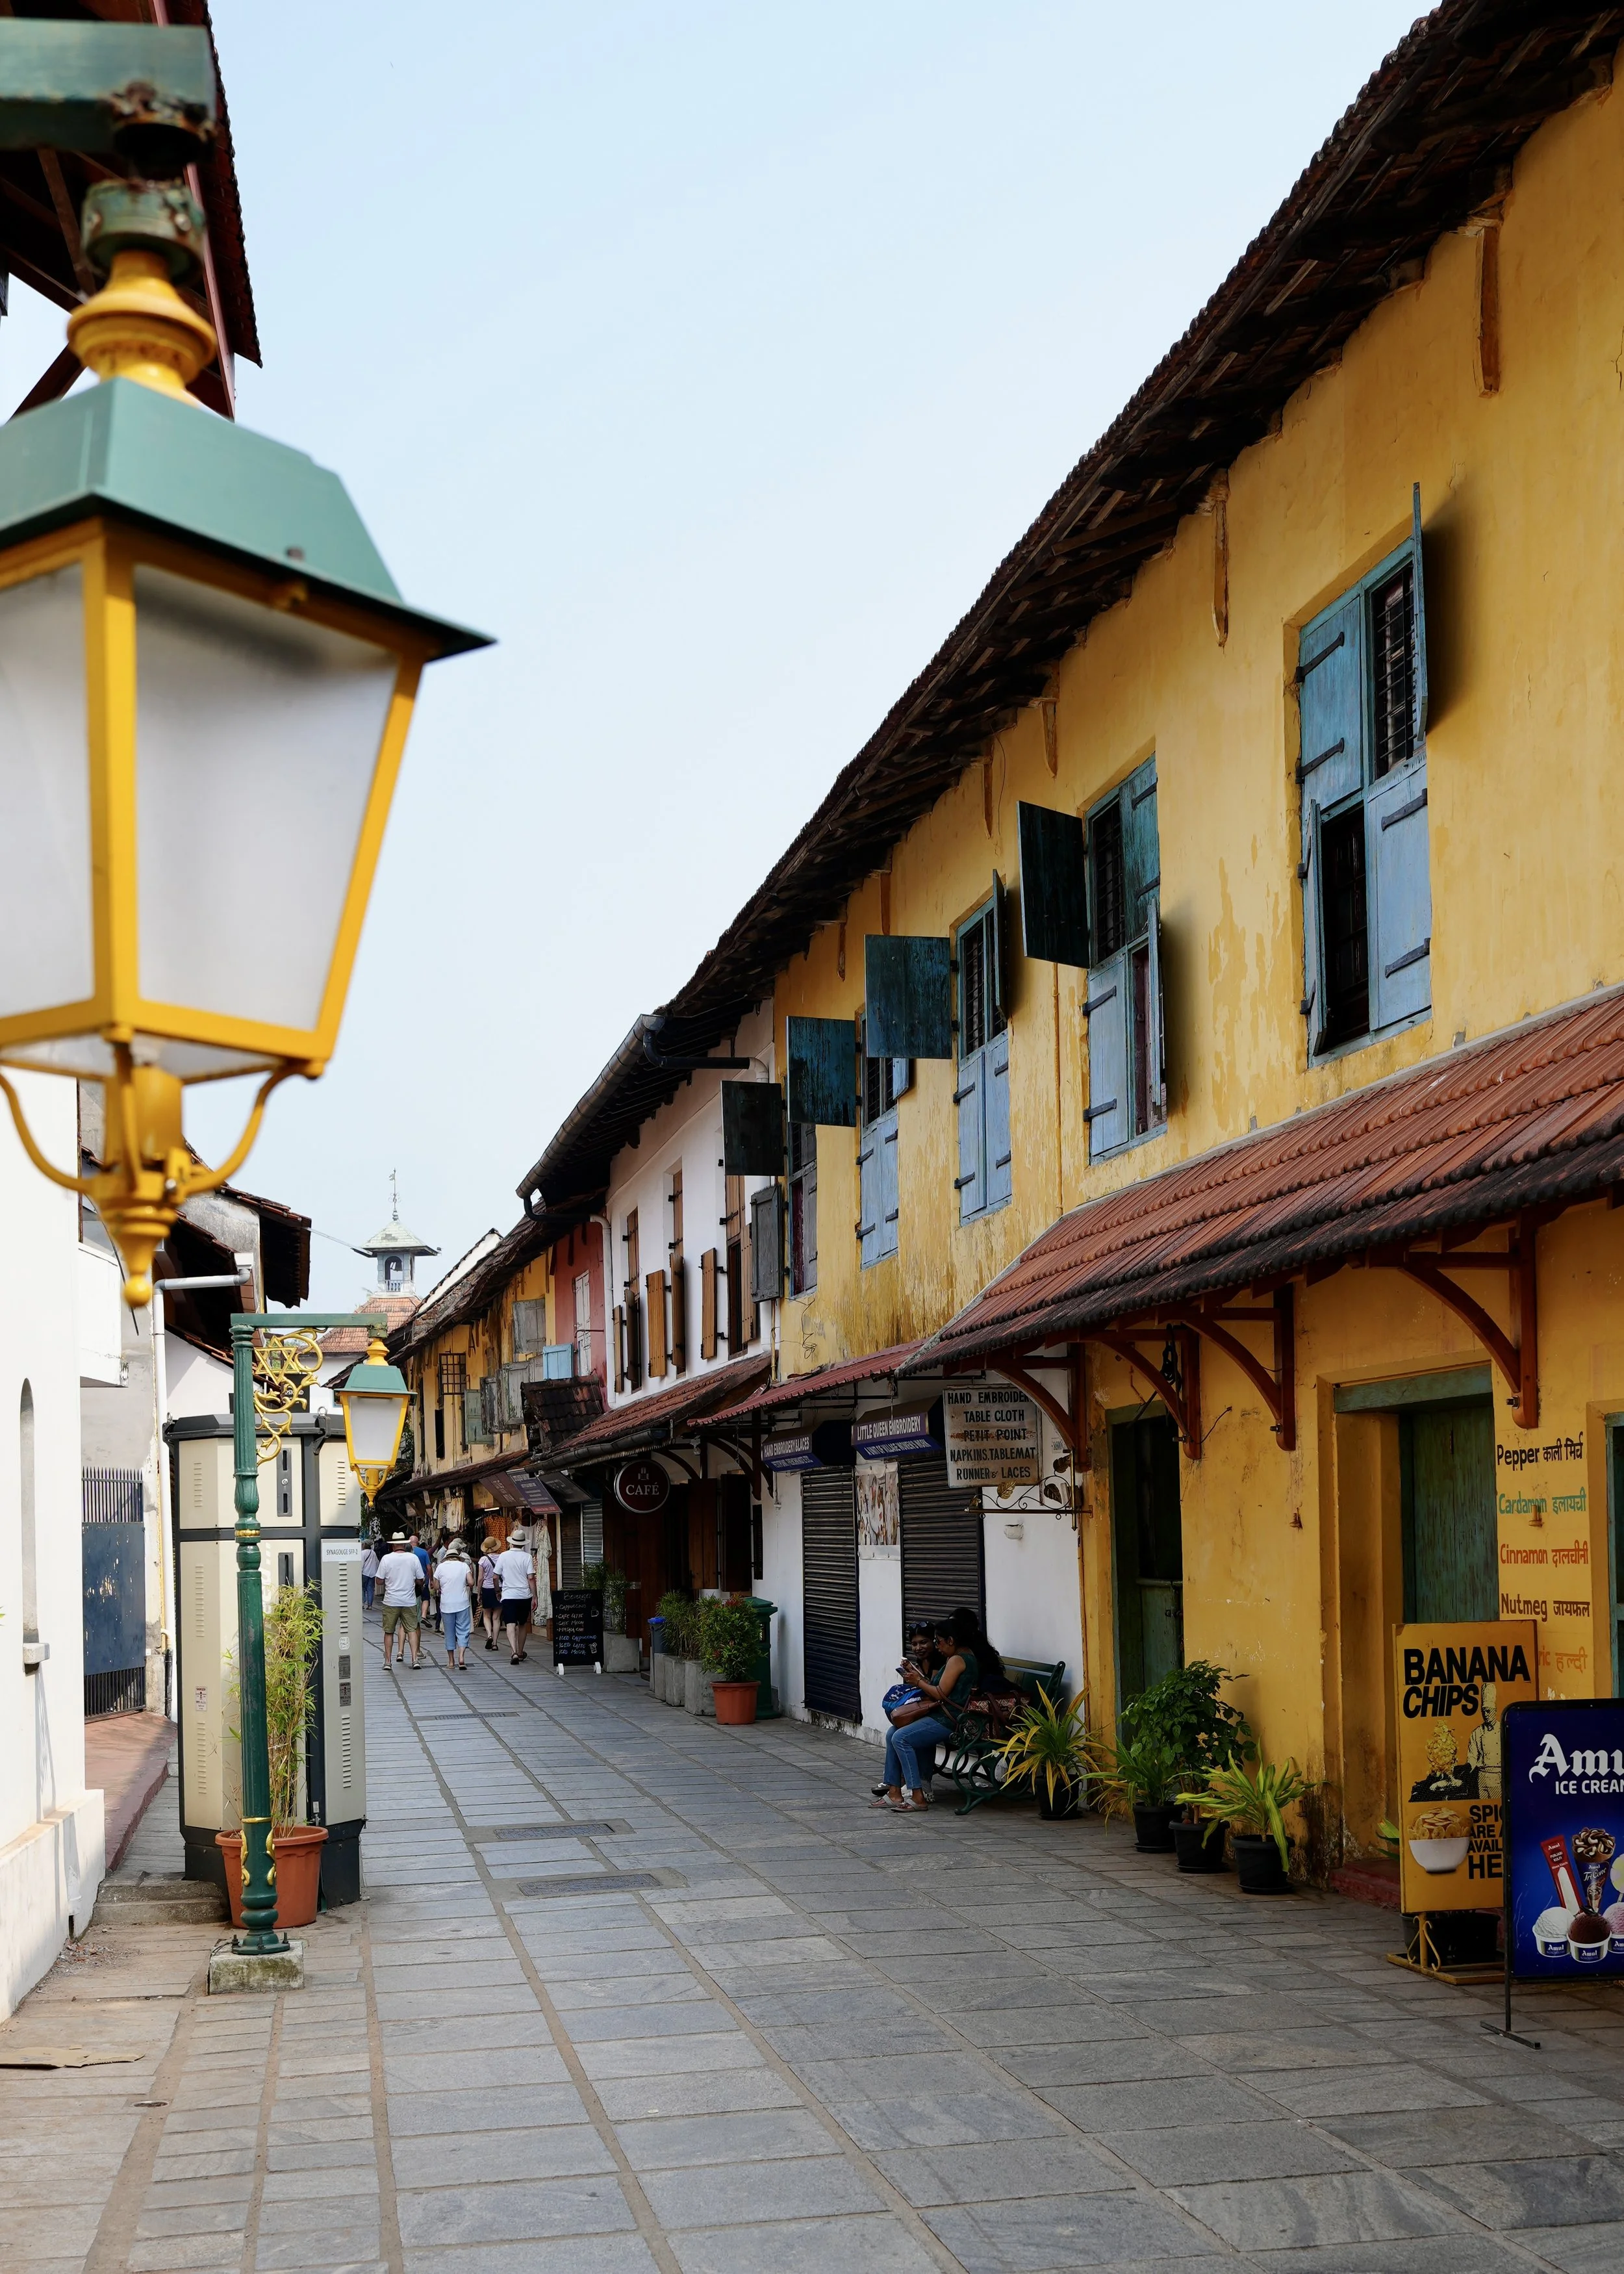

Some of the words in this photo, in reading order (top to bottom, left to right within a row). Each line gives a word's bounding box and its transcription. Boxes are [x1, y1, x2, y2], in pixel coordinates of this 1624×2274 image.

[948, 1392, 972, 1404] HAND
[964, 1410, 991, 1422] TABLE
[995, 1409, 1024, 1422] CLOTH
[857, 1424, 872, 1441] LITTLE
[873, 1420, 888, 1438] QUEEN
[889, 1415, 920, 1435] EMBROIDERY
[964, 1429, 990, 1442] PETIT
[996, 1428, 1027, 1440] POINT
[764, 1444, 774, 1457] HAND
[1497, 1444, 1540, 1471] Pepper
[1543, 1437, 1562, 1462] काली
[1564, 1431, 1583, 1461] मिर्च
[956, 1467, 990, 1480] RUNNER
[1001, 1466, 1030, 1479] LACES
[626, 1482, 659, 1495] CAFÉ
[1552, 1486, 1586, 1515] इलायची
[1500, 1543, 1548, 1565] Cinnamon
[1551, 1539, 1588, 1568] दालचीनी
[1501, 1592, 1547, 1622] Nutmeg
[1553, 1600, 1590, 1617] जायफल
[1404, 1645, 1531, 1685] BANANA
[1555, 1646, 1588, 1674] हल्दी
[1403, 1683, 1479, 1718] CHIPS
[1555, 1781, 1577, 1795] ICE
